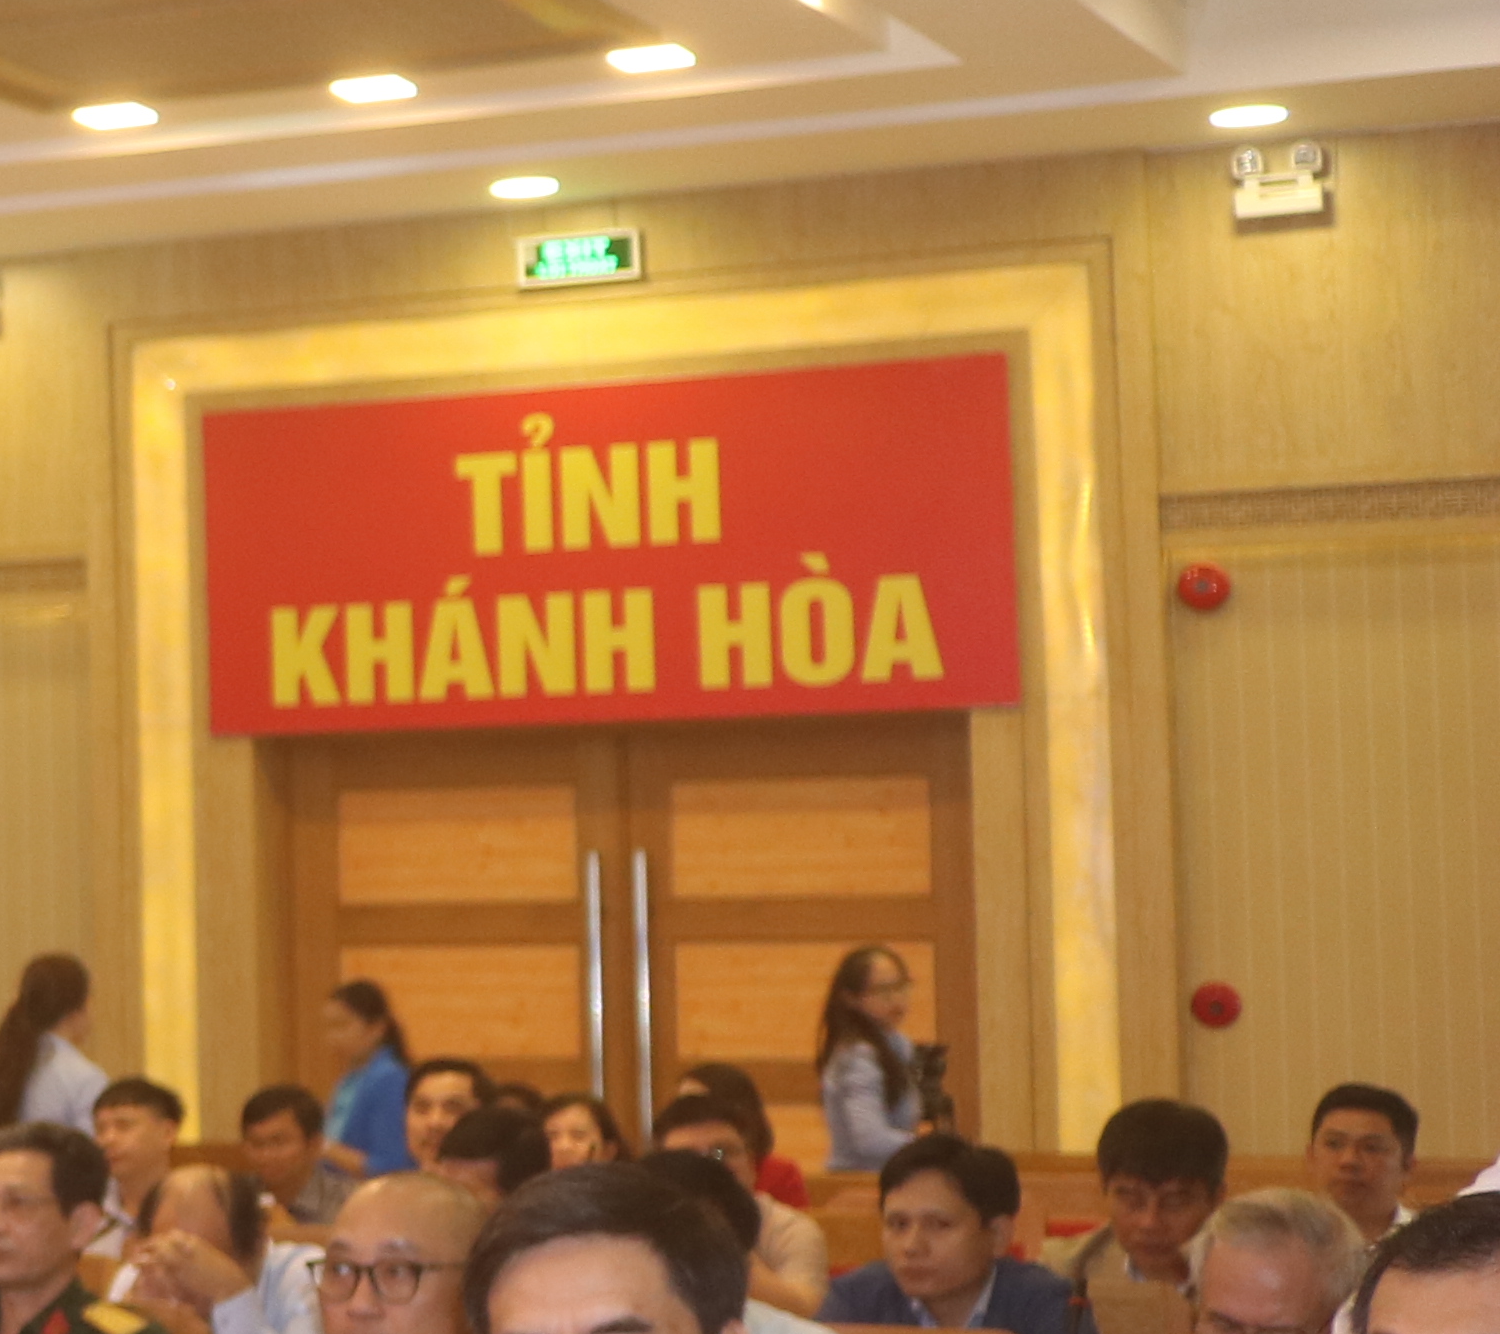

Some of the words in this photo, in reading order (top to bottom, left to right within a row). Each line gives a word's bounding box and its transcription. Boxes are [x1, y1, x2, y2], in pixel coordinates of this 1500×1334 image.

[455, 413, 721, 556] TỈNH
[270, 575, 655, 707] KHÁNH
[698, 552, 943, 688] HÒA
